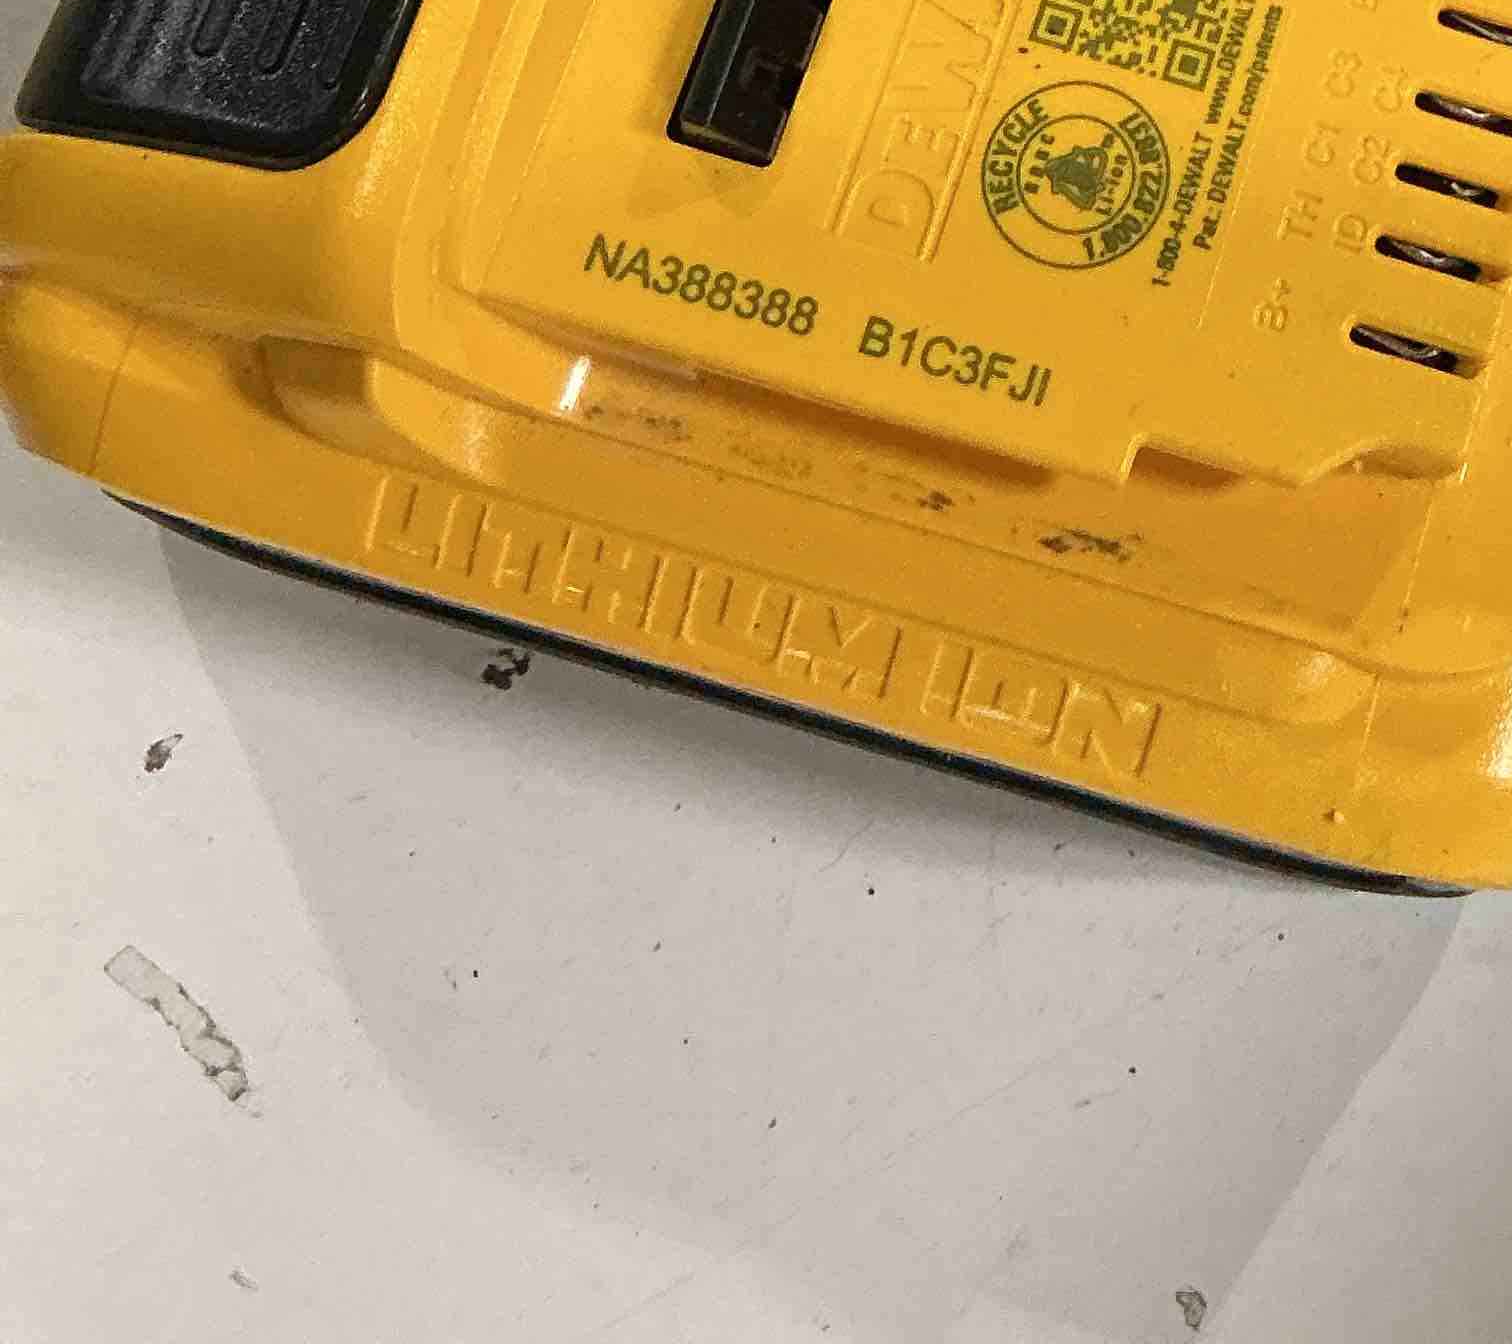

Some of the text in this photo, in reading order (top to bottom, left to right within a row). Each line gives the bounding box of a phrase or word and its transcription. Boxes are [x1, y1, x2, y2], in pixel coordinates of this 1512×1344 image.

[986, 97, 1050, 214] RECYCLE
[1152, 131, 1213, 287] 1-800-4-DEWALT
[583, 232, 819, 337] NA388388
